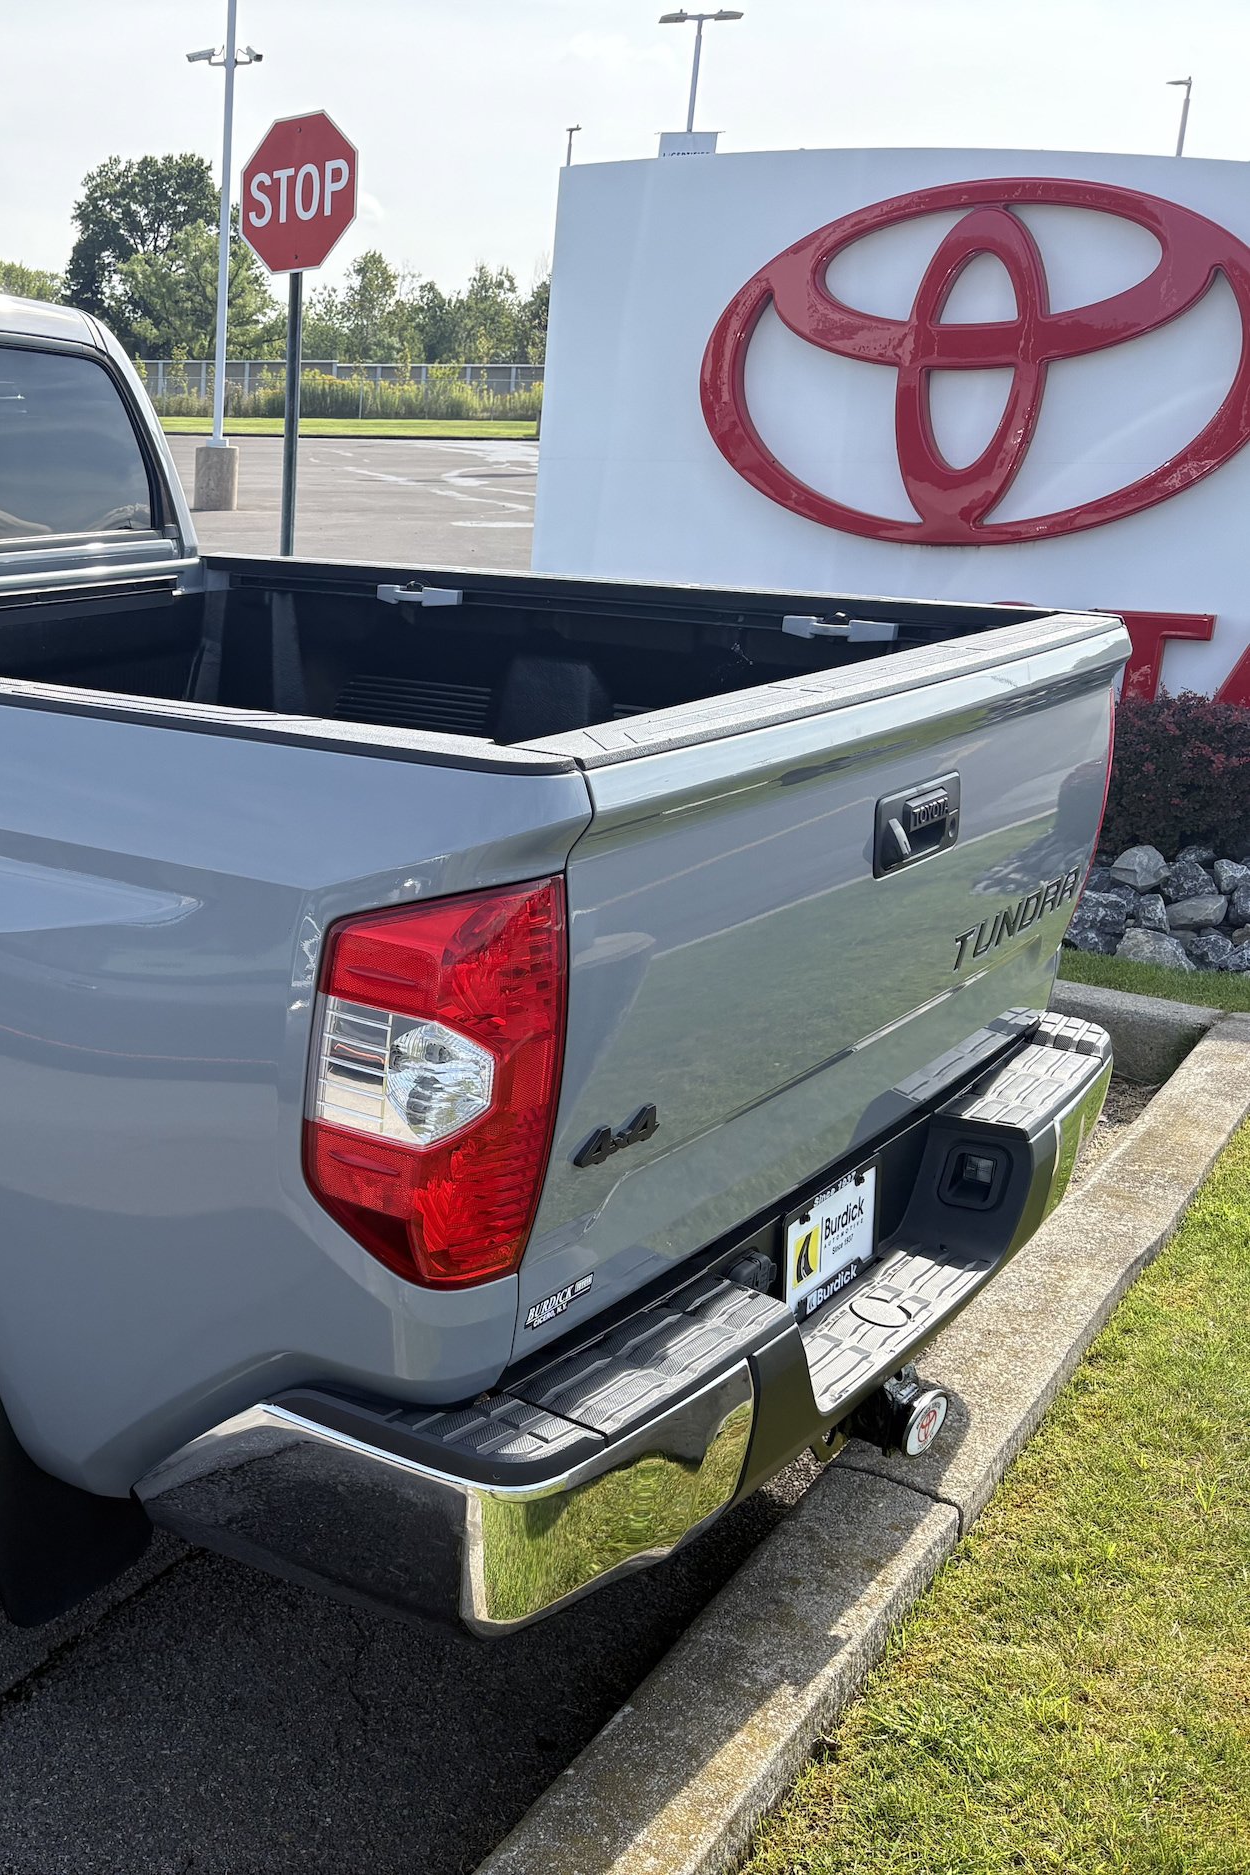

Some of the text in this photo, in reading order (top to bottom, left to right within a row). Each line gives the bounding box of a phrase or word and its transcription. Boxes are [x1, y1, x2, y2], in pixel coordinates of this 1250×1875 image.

[248, 158, 350, 228] STOP
[912, 797, 949, 828] TOYOTA
[953, 863, 1081, 972] TUNDRA
[572, 1103, 660, 1168] 4x4
[813, 1187, 836, 1208] Since
[824, 1196, 865, 1241] Burdick
[824, 1217, 864, 1249] AUTOMOTIVE
[832, 1242, 843, 1255] Since
[526, 1284, 575, 1322] BURDICK
[817, 1264, 858, 1306] Burdick
